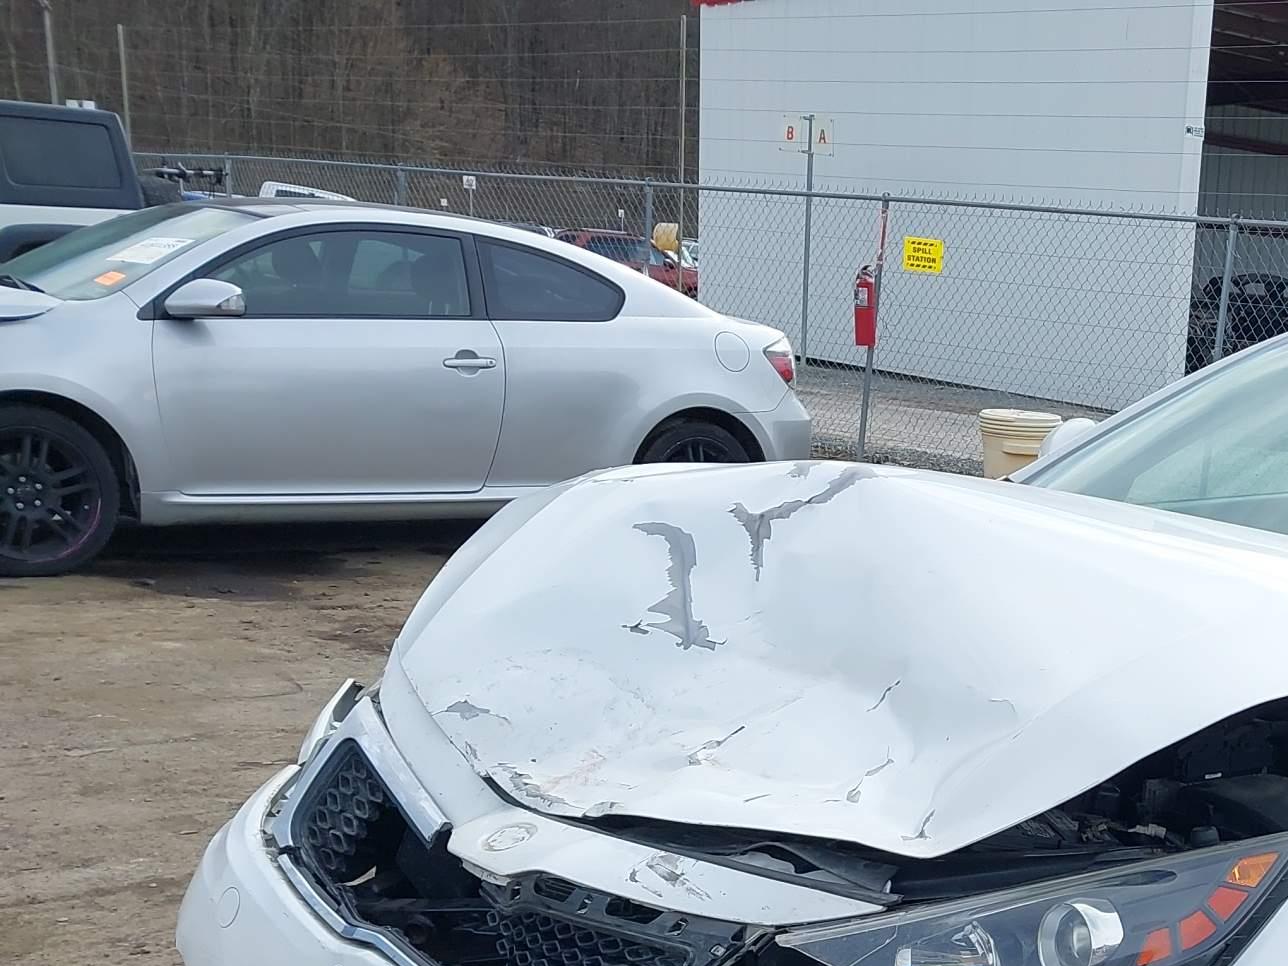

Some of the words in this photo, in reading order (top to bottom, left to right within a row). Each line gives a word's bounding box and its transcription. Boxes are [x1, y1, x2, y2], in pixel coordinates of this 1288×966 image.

[786, 125, 794, 141] B
[818, 128, 827, 144] A
[912, 246, 932, 255] SPILL
[906, 254, 937, 264] STATION
